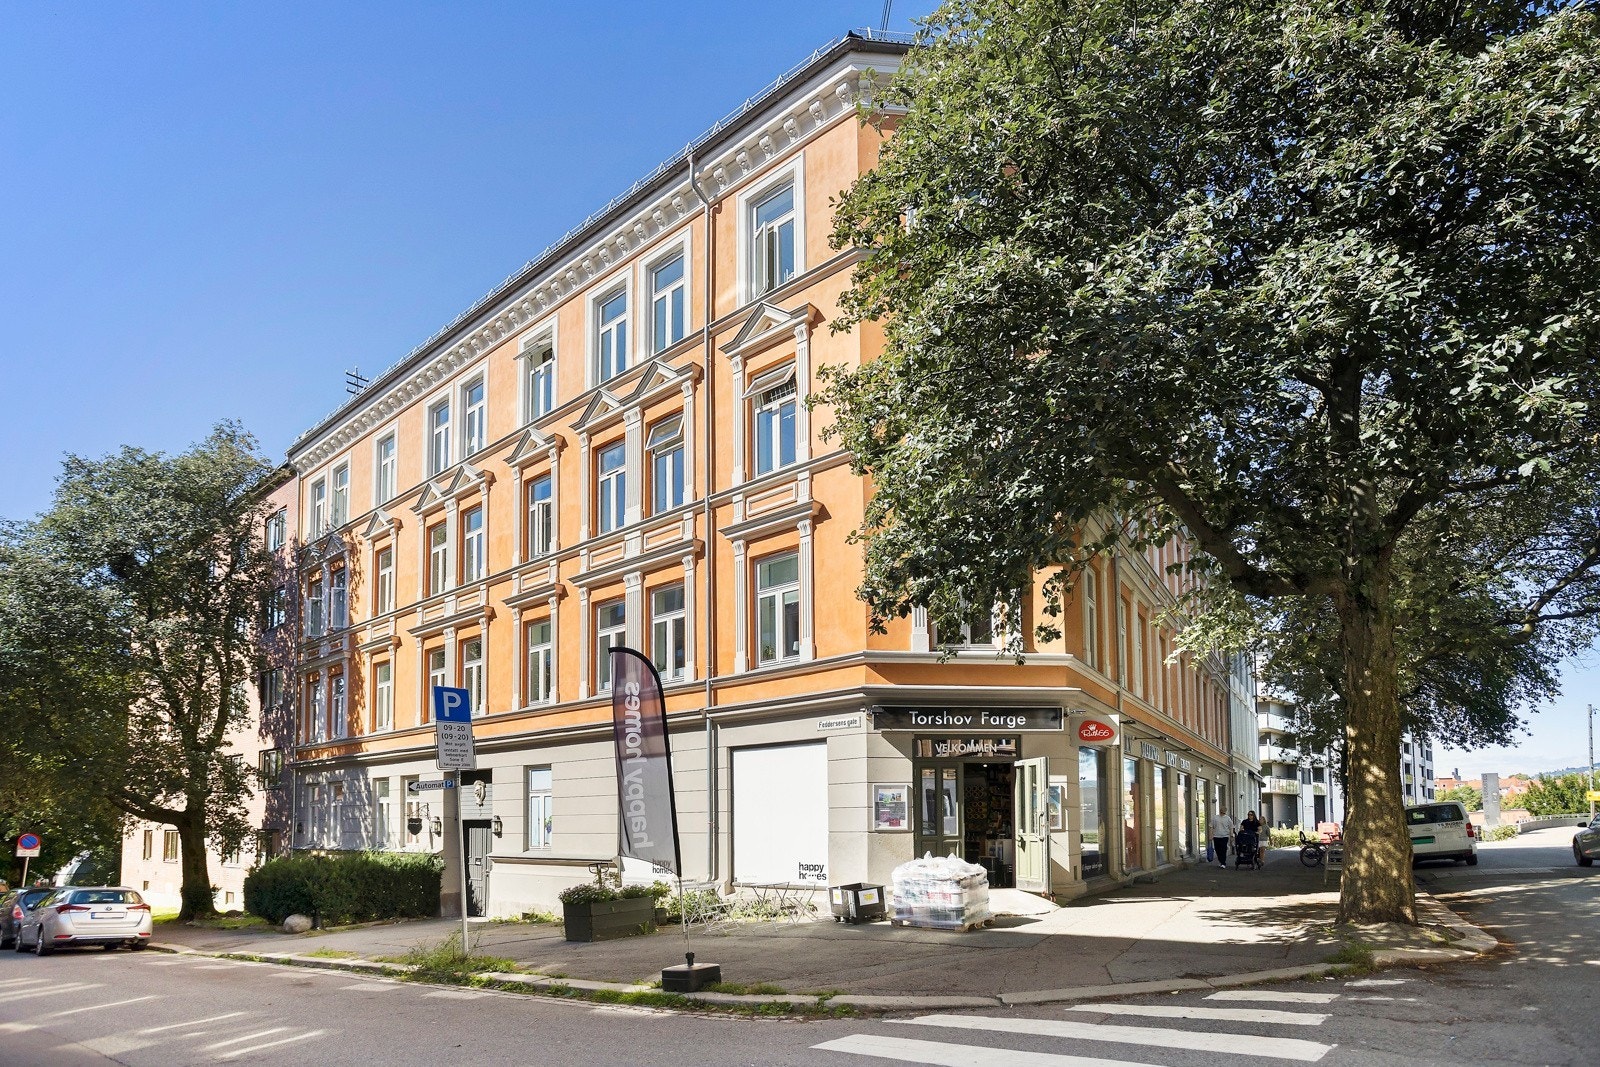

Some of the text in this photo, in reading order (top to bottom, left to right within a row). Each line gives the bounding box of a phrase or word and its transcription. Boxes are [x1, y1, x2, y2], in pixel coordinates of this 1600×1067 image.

[442, 691, 462, 717] P
[908, 710, 1027, 728] Torshov Farge
[934, 743, 998, 753] VELKOMMEN
[798, 861, 825, 873] happy
[798, 870, 827, 880] hoes
